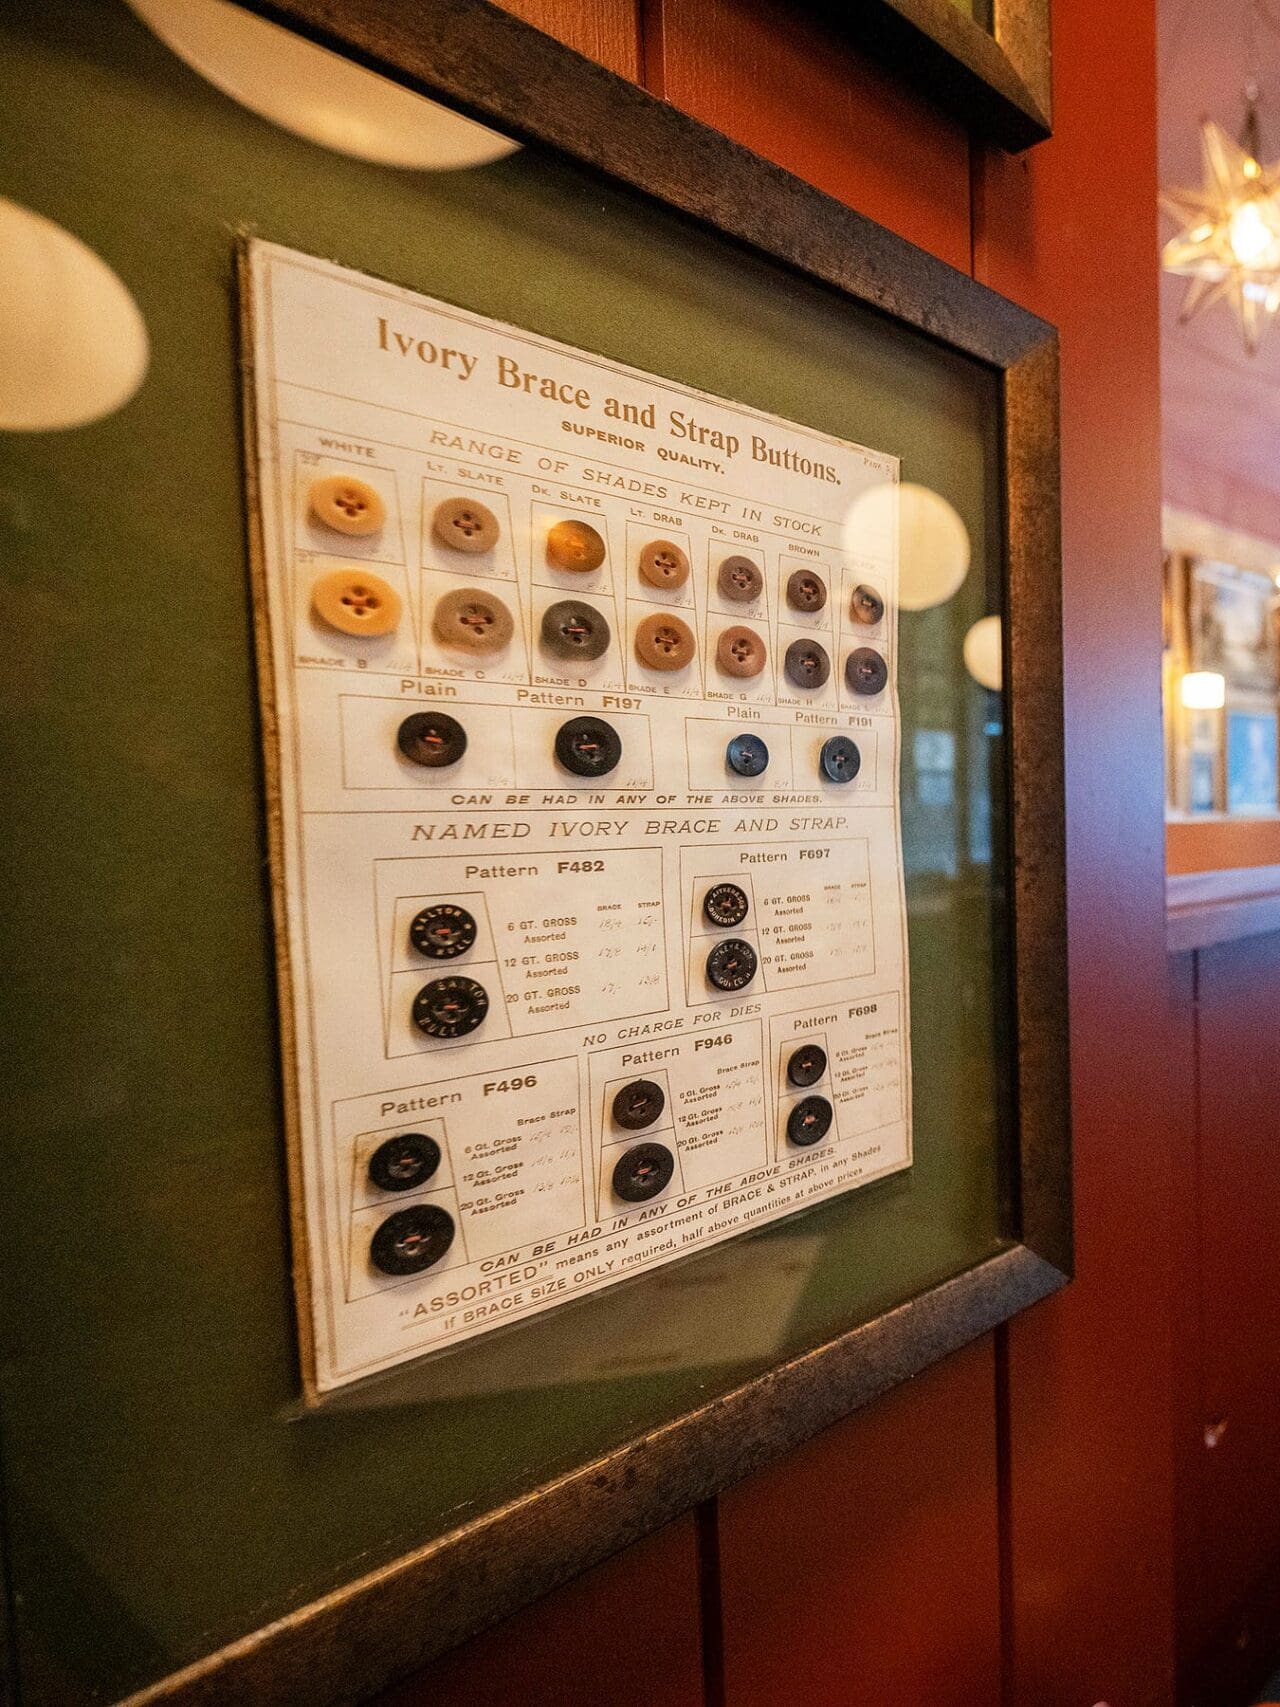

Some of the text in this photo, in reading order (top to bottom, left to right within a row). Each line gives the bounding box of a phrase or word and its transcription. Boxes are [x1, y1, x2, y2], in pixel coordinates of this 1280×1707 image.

[377, 317, 842, 486] Ivory Brace and Strap Buttons.
[319, 437, 376, 458] WHITE
[561, 421, 725, 475] SUPERIOR QUALITY.
[430, 430, 822, 536] RANGE OF SHADES KEPT IN STOCK
[458, 468, 504, 486] SLATE
[560, 491, 601, 507] SLATE
[653, 512, 682, 526] DRAB
[733, 530, 759, 543] DRAB
[788, 543, 819, 557] BROWN
[298, 656, 345, 667] SHADE
[425, 667, 485, 679] SHADE C
[401, 679, 457, 696] Plain
[535, 676, 569, 687] SHADE
[578, 679, 587, 687] D
[628, 684, 657, 693] SHADE
[516, 689, 642, 710] Pattern F197
[707, 691, 733, 700] SHADE
[727, 706, 761, 719] Plain
[795, 712, 872, 727] Pattern F191
[451, 794, 822, 805] CAN BE HAD IN ANY OF THE ABOVE SHADES.
[410, 823, 531, 841] NAMED
[549, 821, 629, 838] IVORY
[644, 819, 721, 835] BRACE
[735, 818, 779, 832] AND
[740, 849, 831, 864] Pattern F697
[465, 860, 605, 879] Pattern F482
[764, 894, 811, 906] 6 GT. GROSS
[774, 906, 803, 916] Assorted
[507, 917, 577, 931] 6 GT. GROSS
[761, 923, 812, 935] 12 GT. GROSS
[524, 931, 566, 944] Assorted
[776, 934, 805, 945] Assorted
[504, 951, 579, 967] 12 GT. GROSS
[762, 951, 814, 964] 20 GT. GROSS
[526, 966, 568, 979] Assorted
[777, 963, 806, 974] Assorted
[506, 985, 581, 1003] 20 GT. GROSS
[528, 1001, 570, 1014] Assorted
[793, 1004, 877, 1030] Pattern F698
[582, 1003, 762, 1047] NO CHARGE FOR DIES
[622, 1034, 733, 1067] Pattern F946
[380, 1076, 537, 1117] Pattern F496
[517, 1108, 576, 1126] Brace Strap
[701, 1107, 722, 1117] Gross
[686, 1114, 719, 1127] Assorted
[493, 1135, 522, 1147] Gross
[702, 1130, 723, 1140] Gross
[685, 1137, 718, 1151] Assorted
[471, 1144, 517, 1161] Assorted
[463, 1174, 474, 1182] 12
[495, 1161, 524, 1174] Gross
[472, 1170, 518, 1187] Assorted
[460, 1203, 473, 1211] 20
[495, 1188, 525, 1201] Gross
[471, 1199, 517, 1216] Assorted
[555, 1249, 599, 1270] means
[606, 1237, 629, 1253] any
[637, 1210, 703, 1241] assortment
[707, 1203, 719, 1215] of
[723, 1189, 762, 1209] BRACE
[767, 1184, 775, 1193] &
[820, 1164, 829, 1173] in
[832, 1158, 848, 1171] any
[851, 1145, 881, 1162] Shades
[480, 1253, 520, 1272] CAN
[532, 1242, 556, 1256] BE
[567, 1227, 602, 1246] HAD
[612, 1217, 628, 1231] IN
[638, 1203, 668, 1222] ANY
[677, 1195, 698, 1208] OF
[706, 1183, 731, 1198] THE
[740, 1166, 781, 1186] ABOVE
[444, 1167, 863, 1330] If BRACE SIZE ONLY required, half above quantities at above prices
